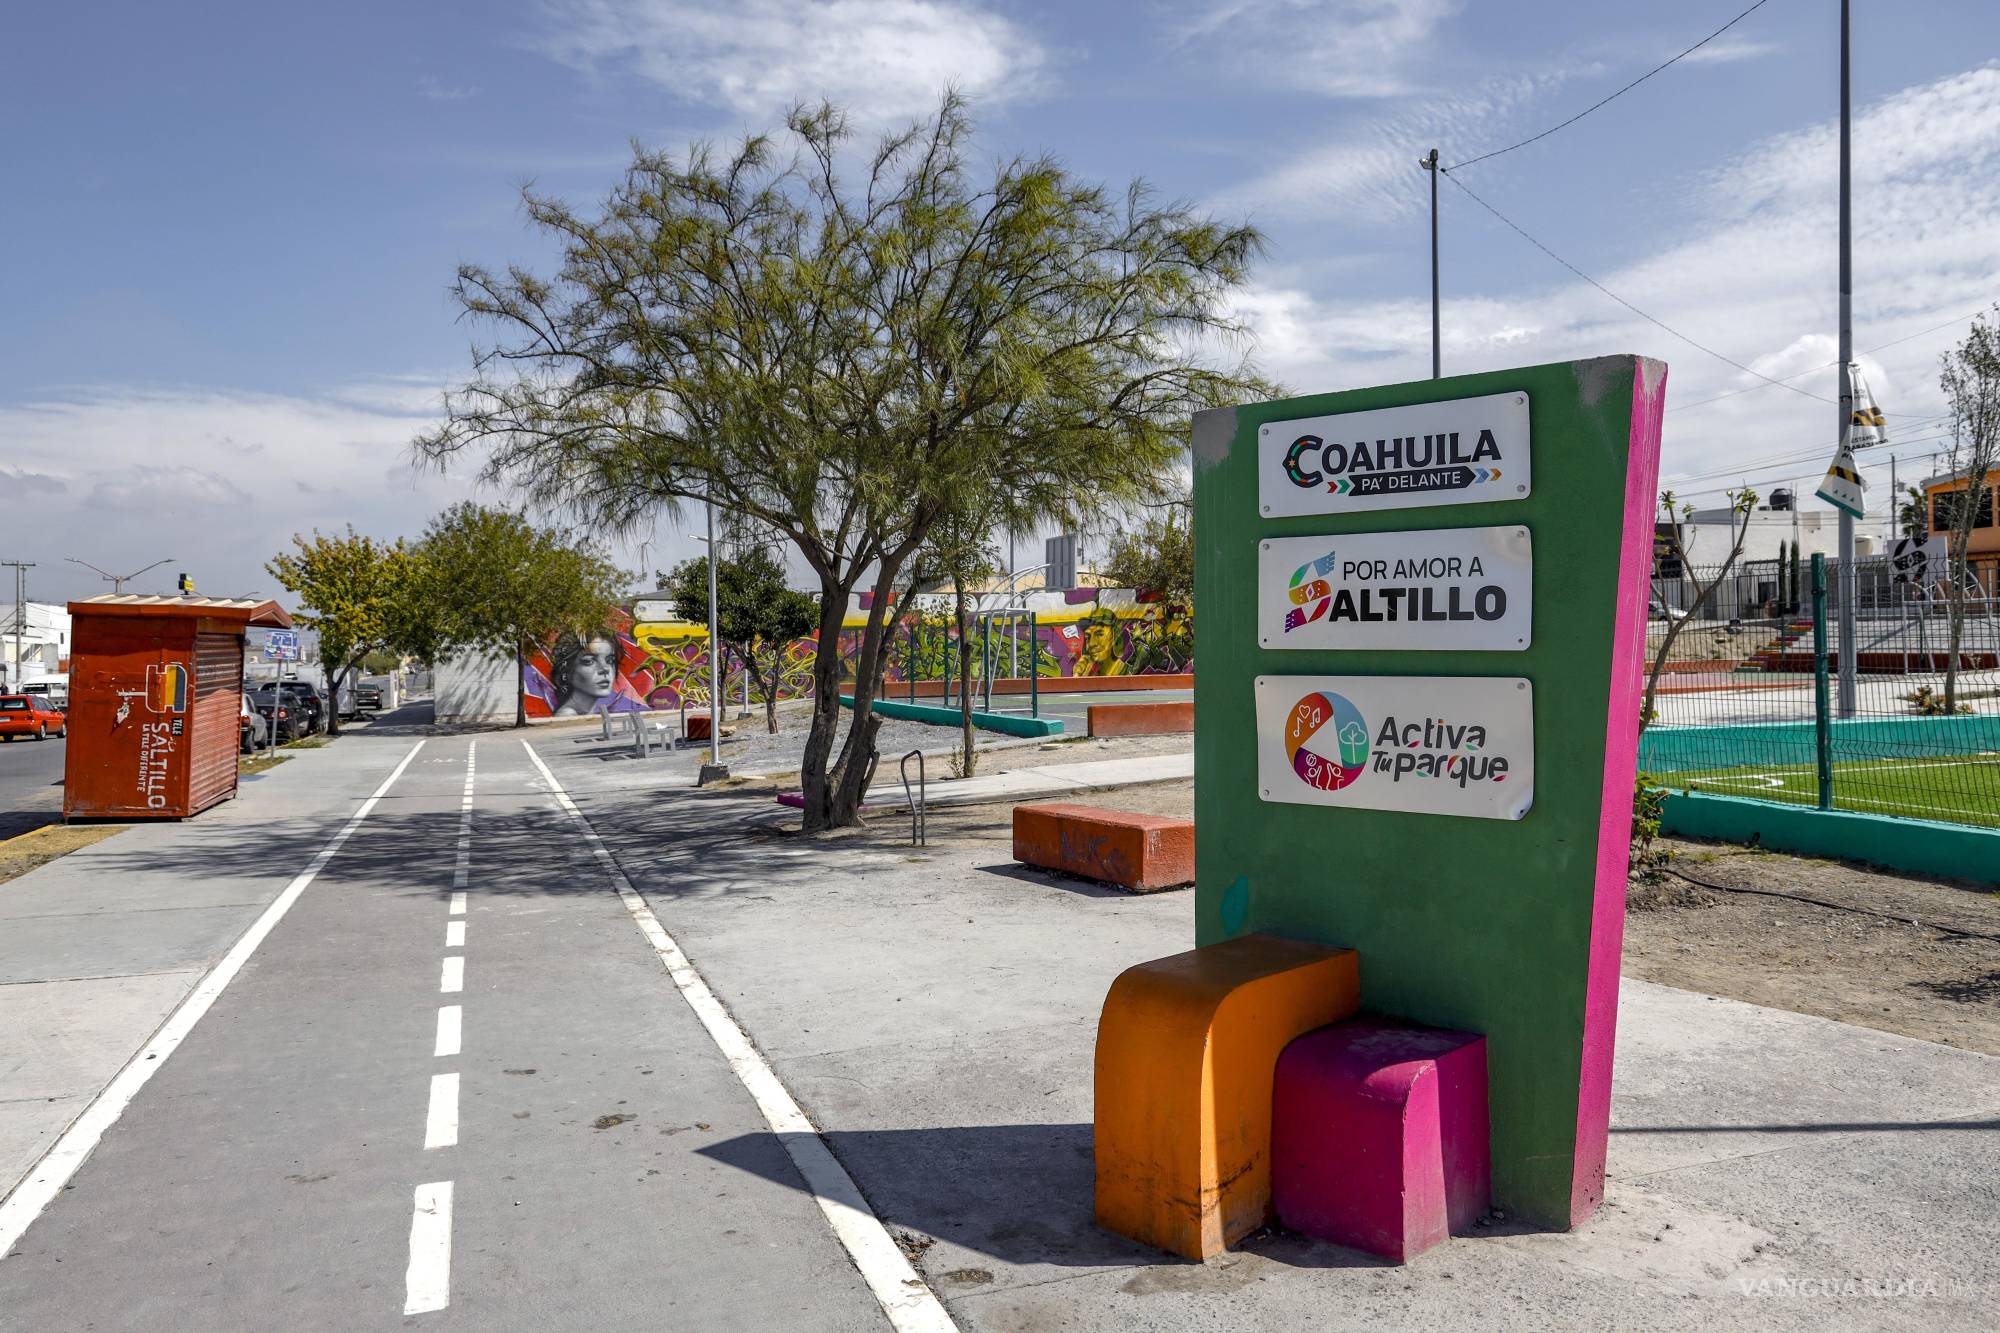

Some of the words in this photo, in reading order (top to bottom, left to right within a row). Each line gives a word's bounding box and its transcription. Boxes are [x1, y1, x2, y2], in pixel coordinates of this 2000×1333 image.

[1282, 429, 1502, 488] COAHUILA
[1388, 471, 1461, 489] DELANTE
[1343, 560, 1387, 580] POR
[1393, 557, 1462, 579] AMOR
[1468, 556, 1484, 577] A
[141, 733, 150, 749] TELE
[142, 723, 150, 732] LA
[172, 719, 183, 735] TELE
[1375, 716, 1487, 751] Activa
[137, 750, 148, 792] DIFERENTE
[147, 722, 169, 808] SALTILLO
[1393, 752, 1509, 788] parque
